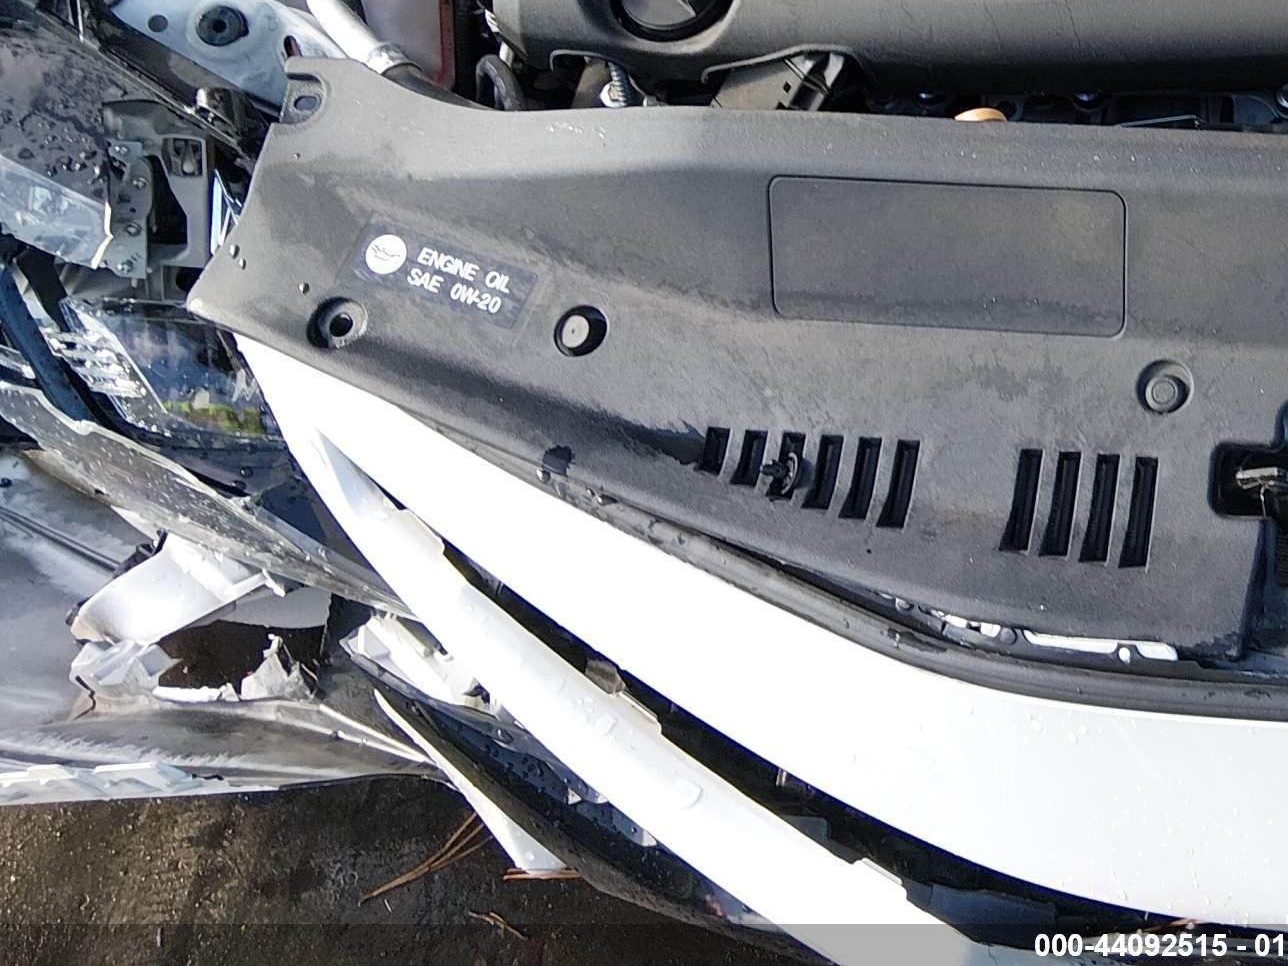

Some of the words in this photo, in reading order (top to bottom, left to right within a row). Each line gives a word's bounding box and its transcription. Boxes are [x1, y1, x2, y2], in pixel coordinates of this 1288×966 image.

[407, 267, 444, 294] SAE
[449, 282, 502, 314] 0W-20
[417, 246, 480, 282] ENGINE
[485, 270, 510, 294] OIL
